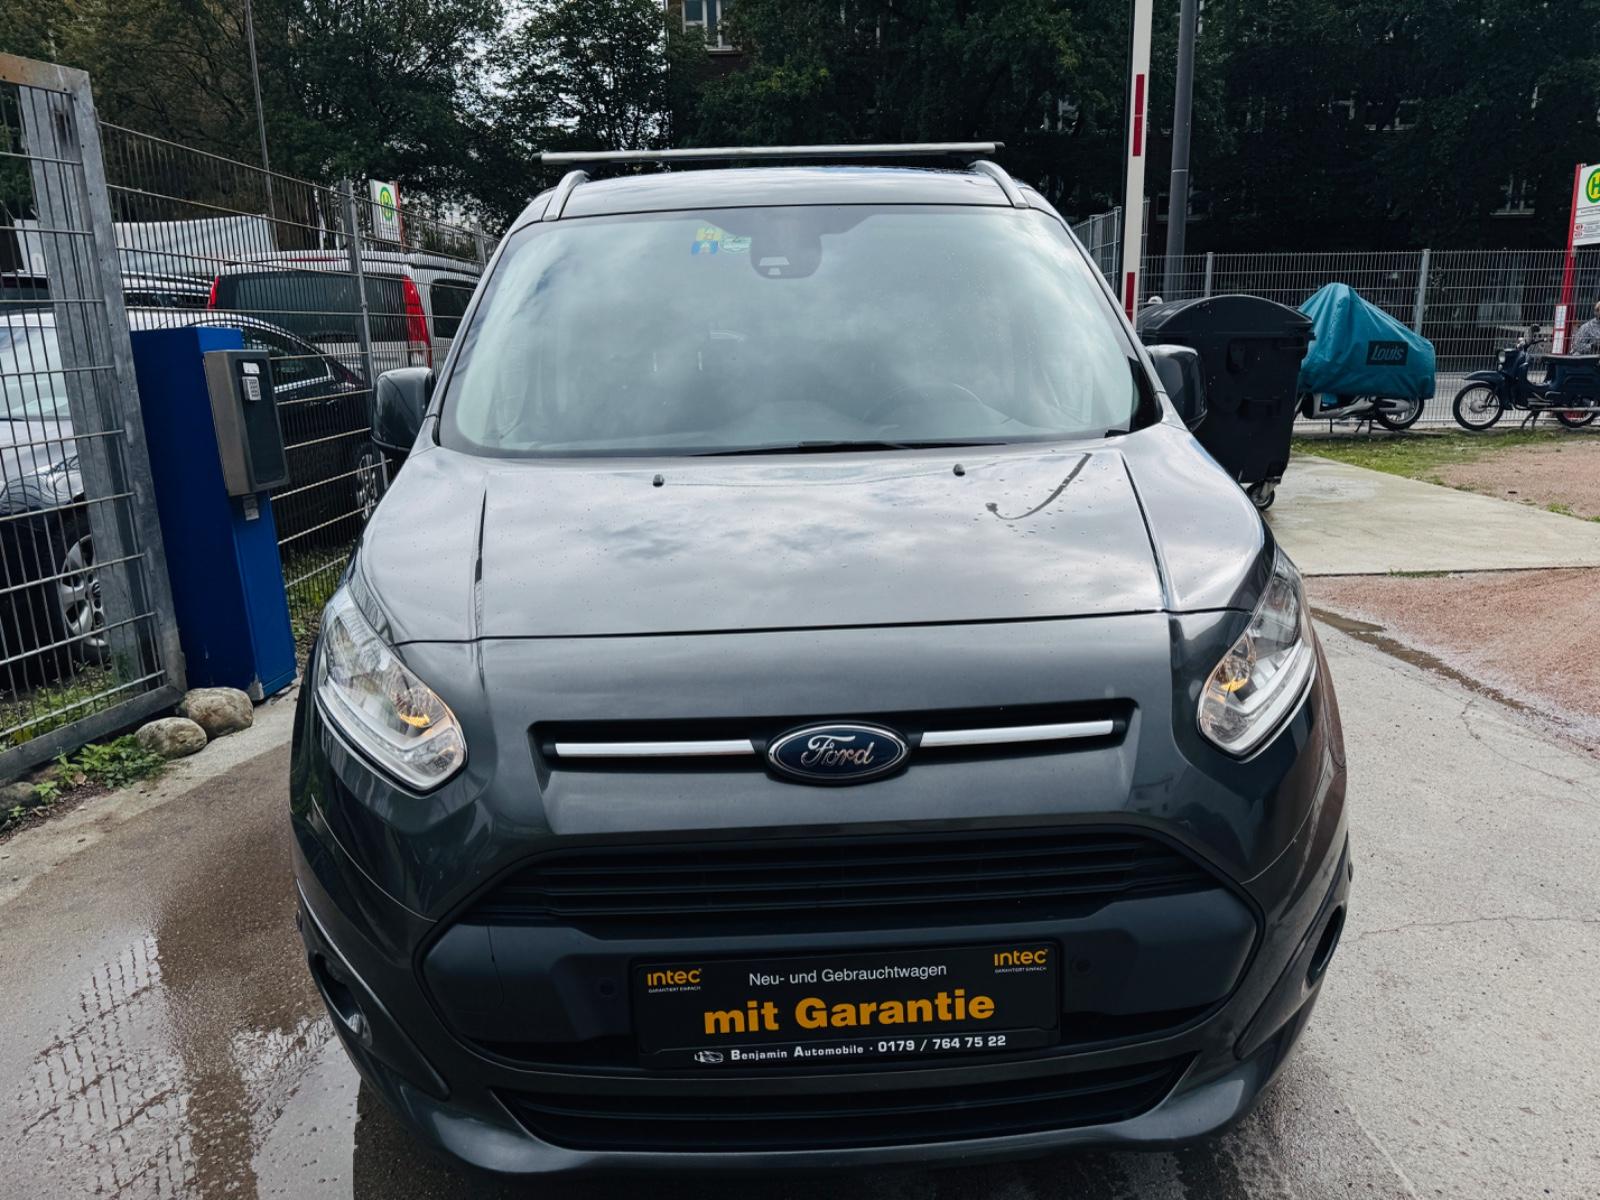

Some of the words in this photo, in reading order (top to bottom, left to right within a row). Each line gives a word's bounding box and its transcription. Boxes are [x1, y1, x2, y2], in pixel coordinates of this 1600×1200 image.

[1370, 343, 1405, 361] Louis
[801, 734, 875, 768] Ford
[993, 949, 1048, 967] intec
[647, 968, 702, 986] intec
[749, 972, 785, 986] Neu-
[789, 970, 818, 984] und
[821, 964, 948, 983] Gebrauchtwagen
[703, 1000, 780, 1035] mit
[795, 988, 996, 1030] Garantie
[730, 1048, 788, 1063] Benjamin
[793, 1045, 864, 1058] Automobile
[877, 1039, 915, 1053] 0179
[932, 1037, 960, 1050] 764
[964, 1036, 983, 1049] 75
[987, 1034, 1007, 1047] 22
